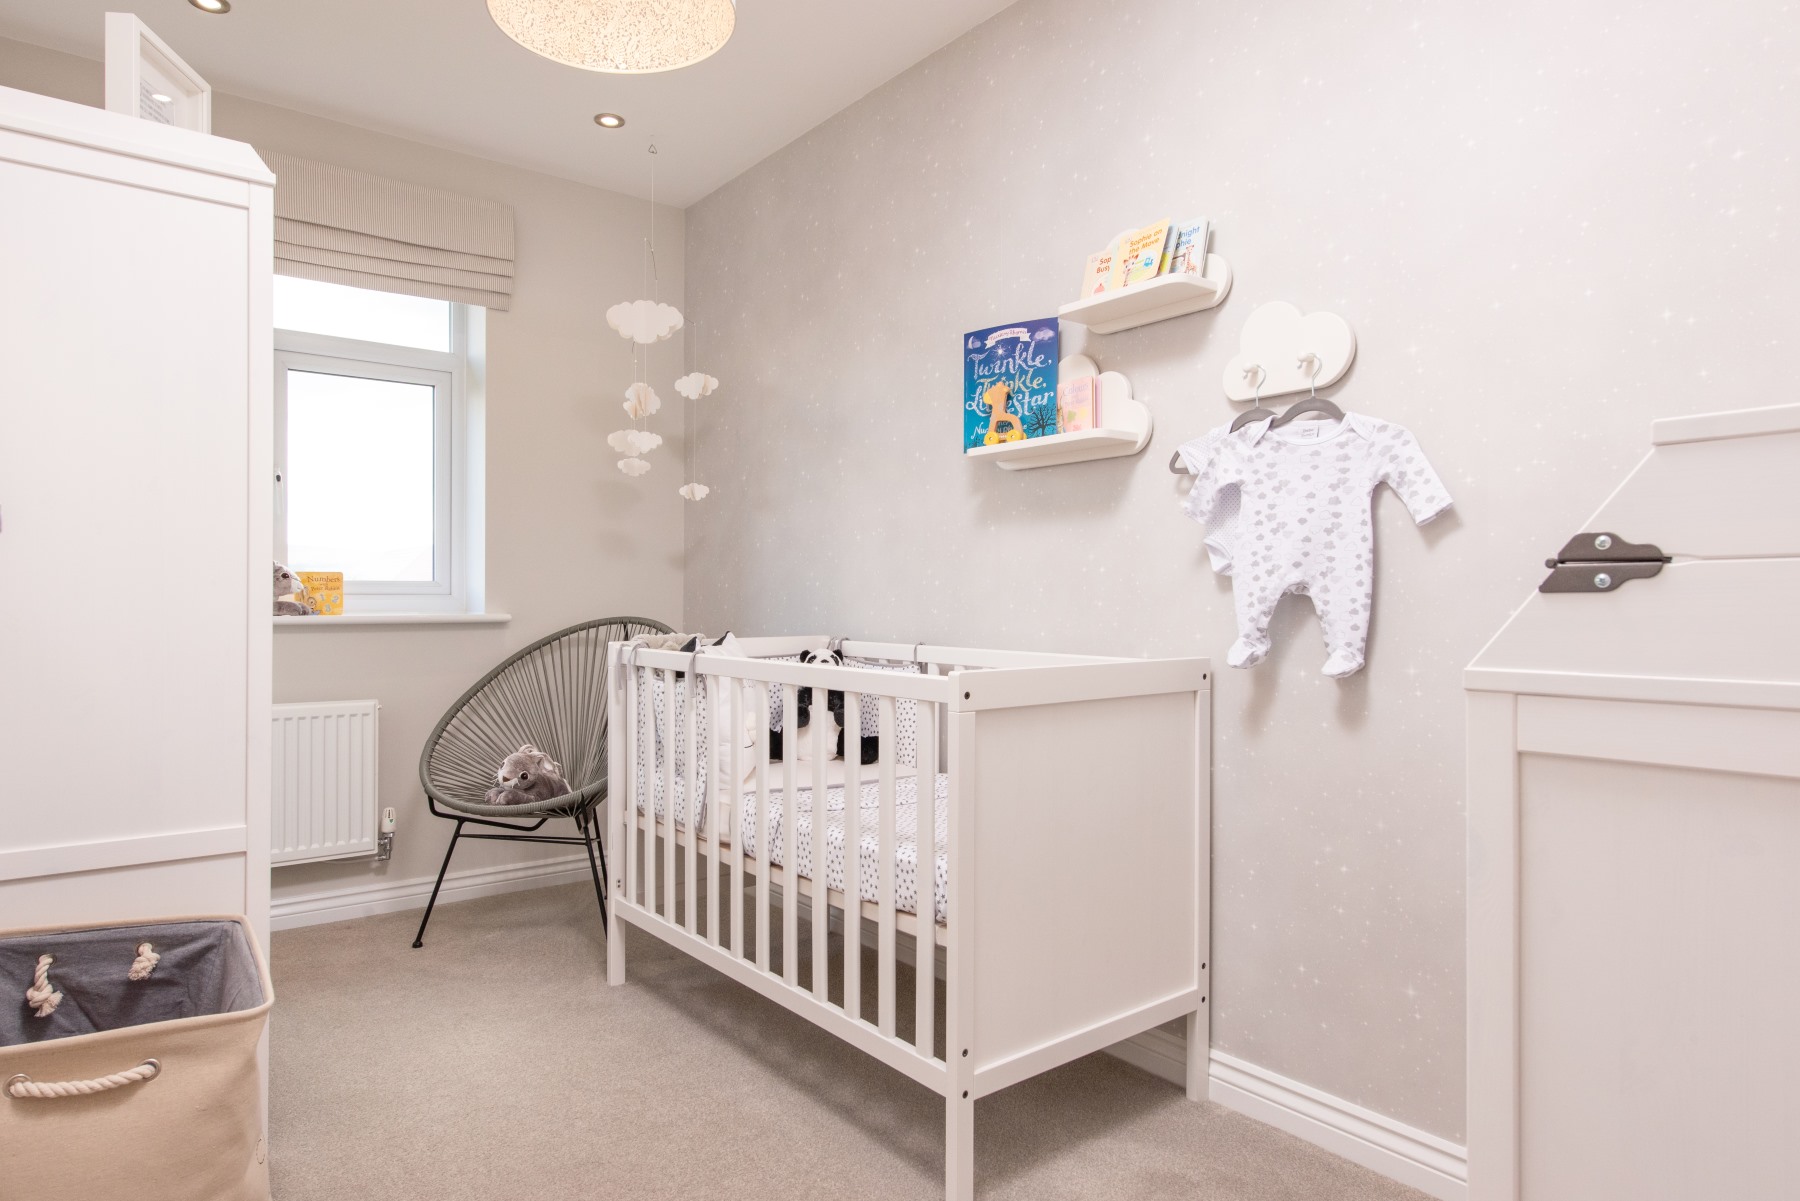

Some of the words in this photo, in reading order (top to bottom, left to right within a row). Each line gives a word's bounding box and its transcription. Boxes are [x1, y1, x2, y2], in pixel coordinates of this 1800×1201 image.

[1130, 234, 1152, 247] Sophie
[1141, 237, 1159, 250] Move
[1175, 238, 1192, 249] phie
[1099, 257, 1112, 266] Sop
[967, 341, 1052, 380] Twinkle,
[1012, 391, 1055, 418] Star
